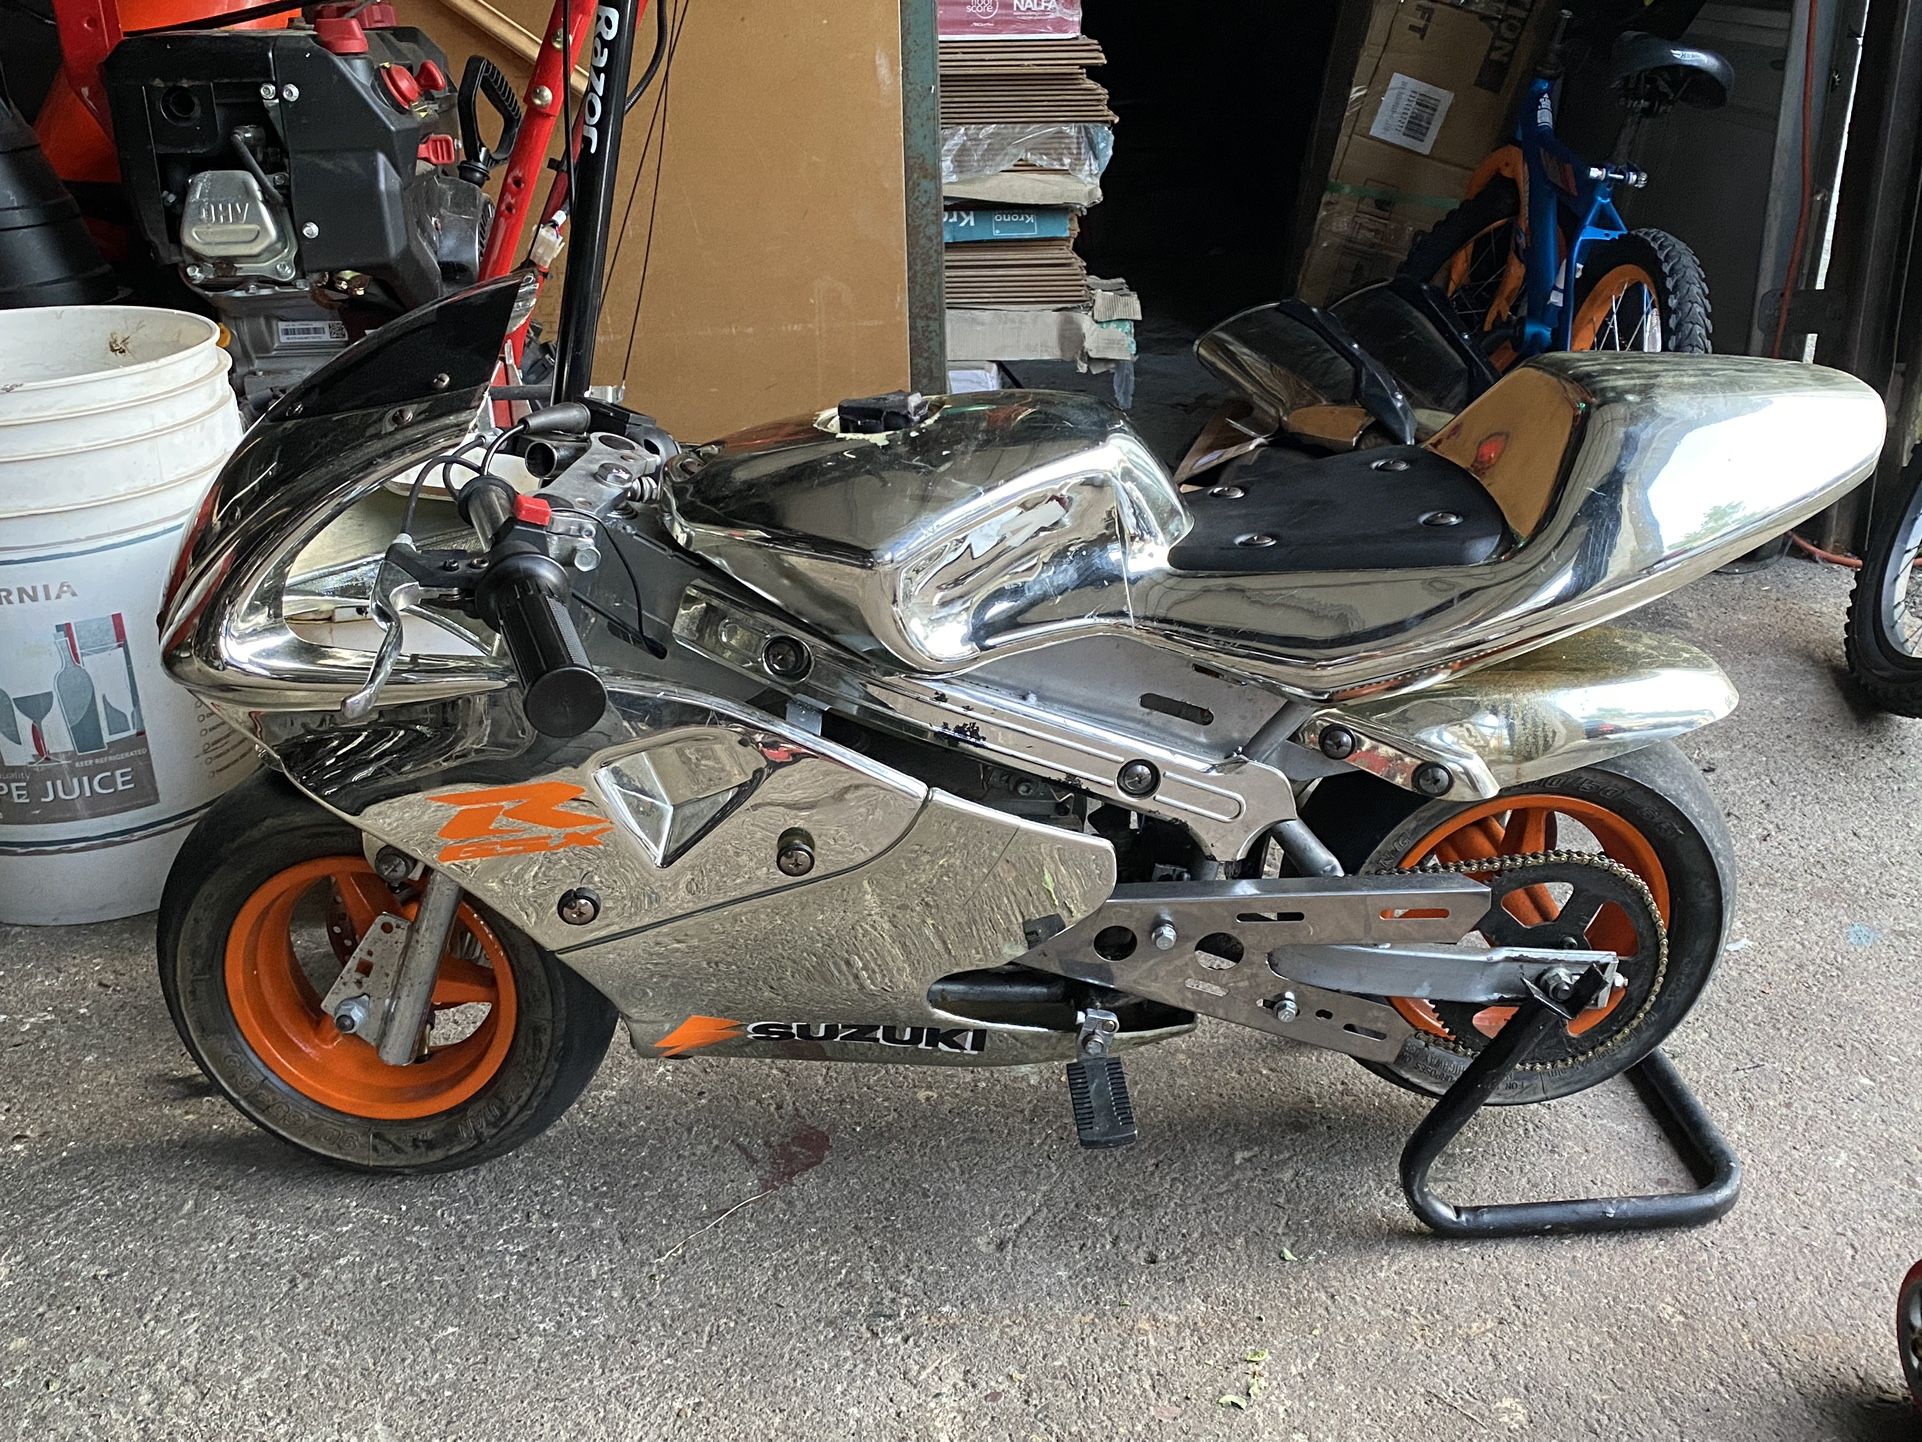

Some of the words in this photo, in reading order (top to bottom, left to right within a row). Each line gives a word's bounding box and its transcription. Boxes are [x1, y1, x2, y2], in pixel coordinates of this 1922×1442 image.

[966, 5, 994, 13] score
[583, 5, 620, 154] Razor
[202, 203, 249, 223] OHV
[995, 214, 1035, 223] Krono
[41, 767, 135, 802] JUICE
[746, 1021, 987, 1054] SUZUKI
[1414, 1062, 1457, 1083] URPOSES
